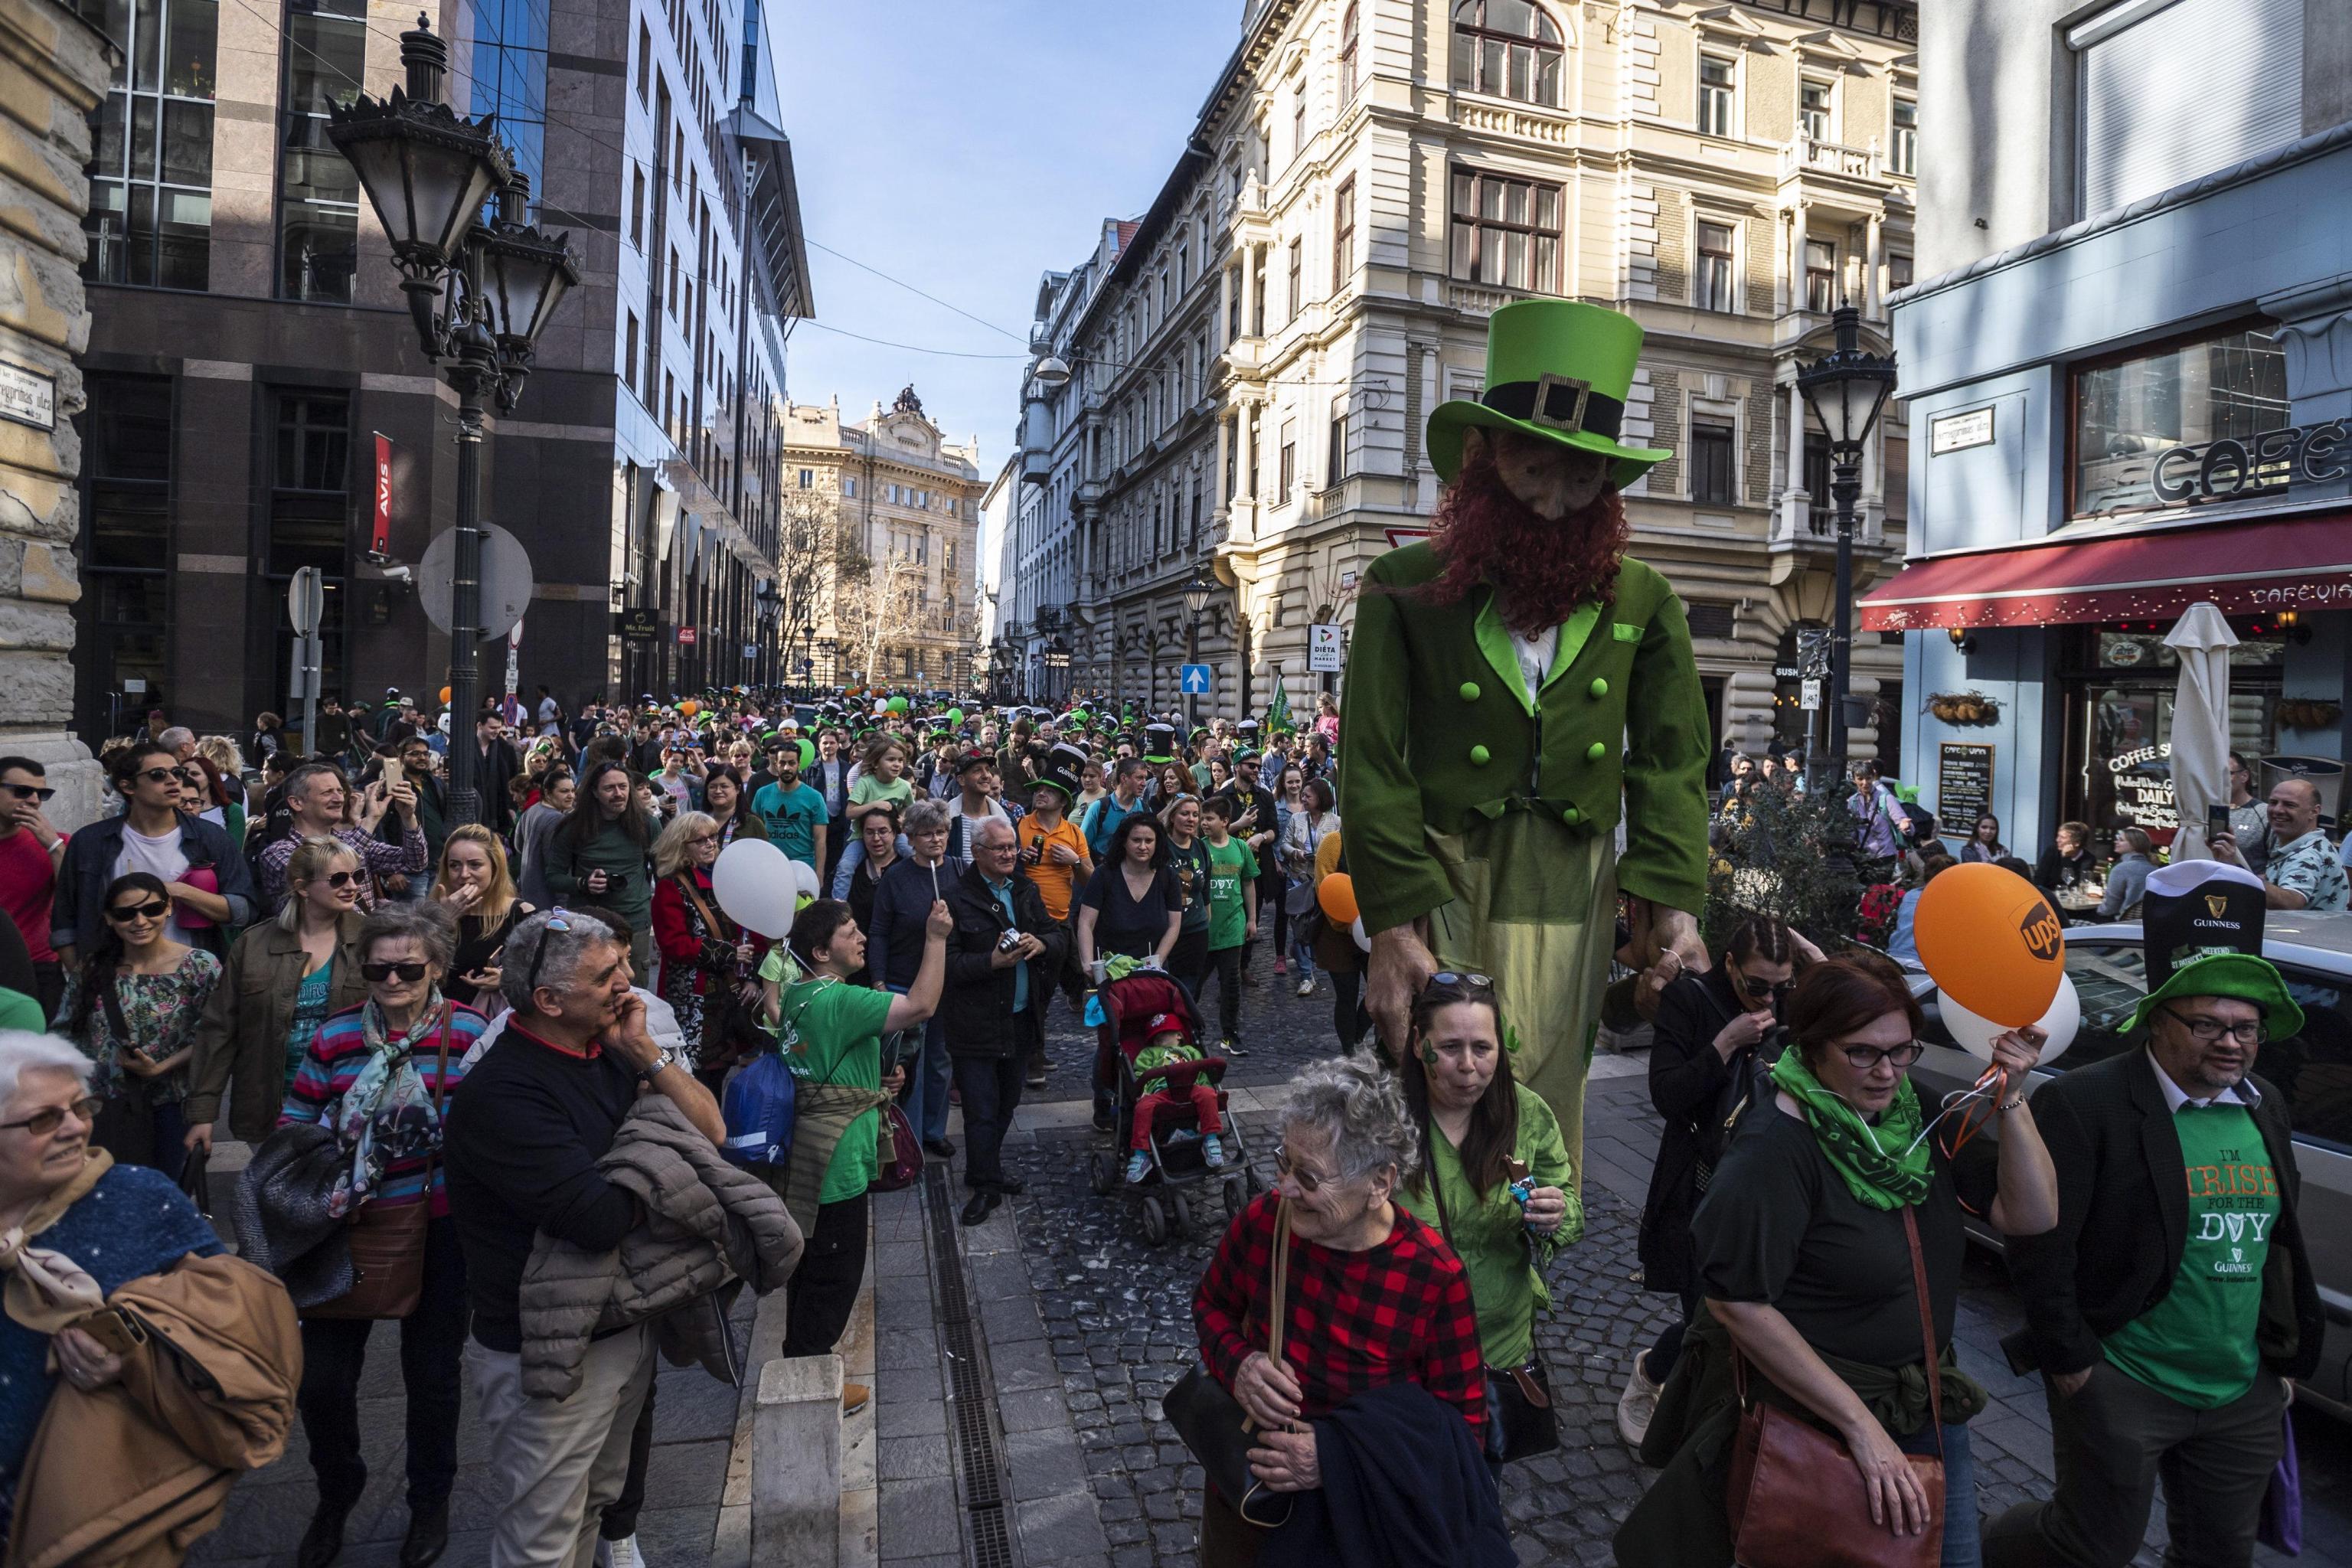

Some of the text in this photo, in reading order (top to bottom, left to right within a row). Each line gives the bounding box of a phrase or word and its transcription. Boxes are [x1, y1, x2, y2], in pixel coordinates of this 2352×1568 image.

[380, 462, 389, 518] AVIS
[1776, 668, 1798, 676] SUSH
[2108, 746, 2156, 772] COFFEE
[1057, 766, 1079, 782] GUINNESS
[2137, 788, 2174, 805] DAILY
[2194, 919, 2240, 929] GUINNESS
[2022, 914, 2060, 955] ups
[2200, 946, 2230, 955] WEEKEND
[2220, 1150, 2241, 1161] I'M
[2186, 1165, 2279, 1197] IRISH
[2207, 1197, 2265, 1210] FOR THE
